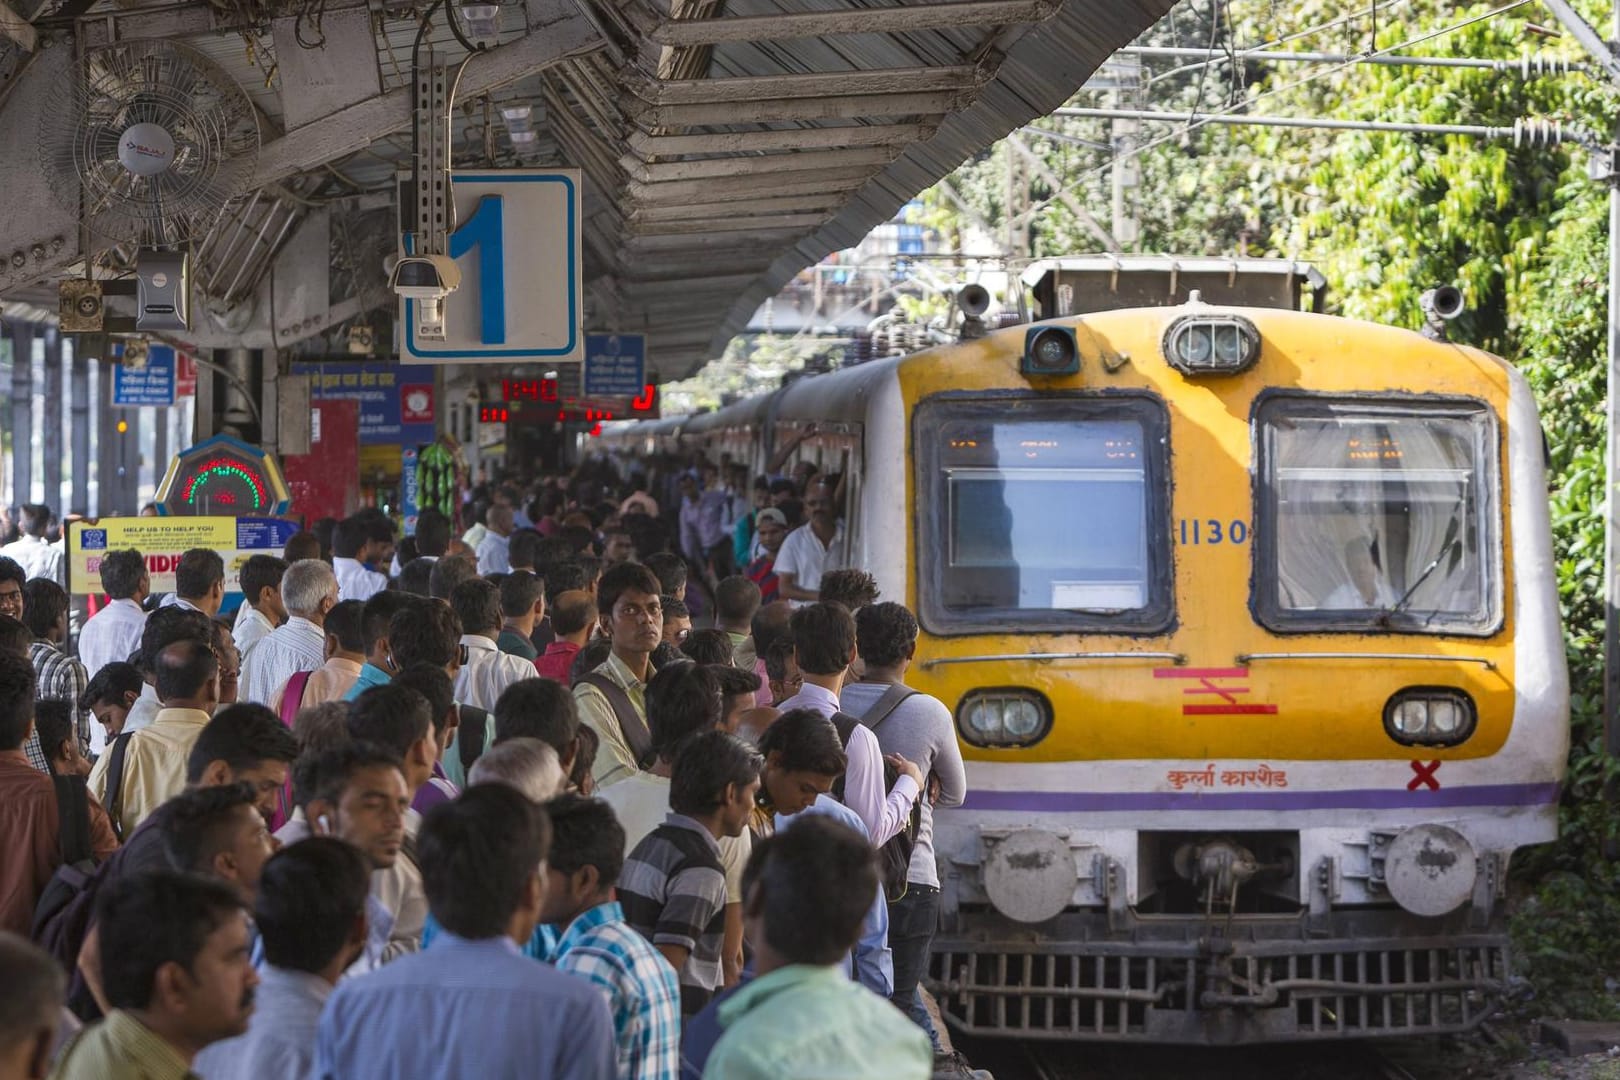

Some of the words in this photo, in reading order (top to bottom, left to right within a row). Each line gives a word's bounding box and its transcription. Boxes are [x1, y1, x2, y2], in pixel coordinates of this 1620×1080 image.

[448, 193, 505, 344] 1
[404, 463, 418, 505] pepsi
[197, 524, 214, 532] YOU
[1181, 519, 1247, 545] 1130
[1167, 763, 1215, 790] कुर्ला
